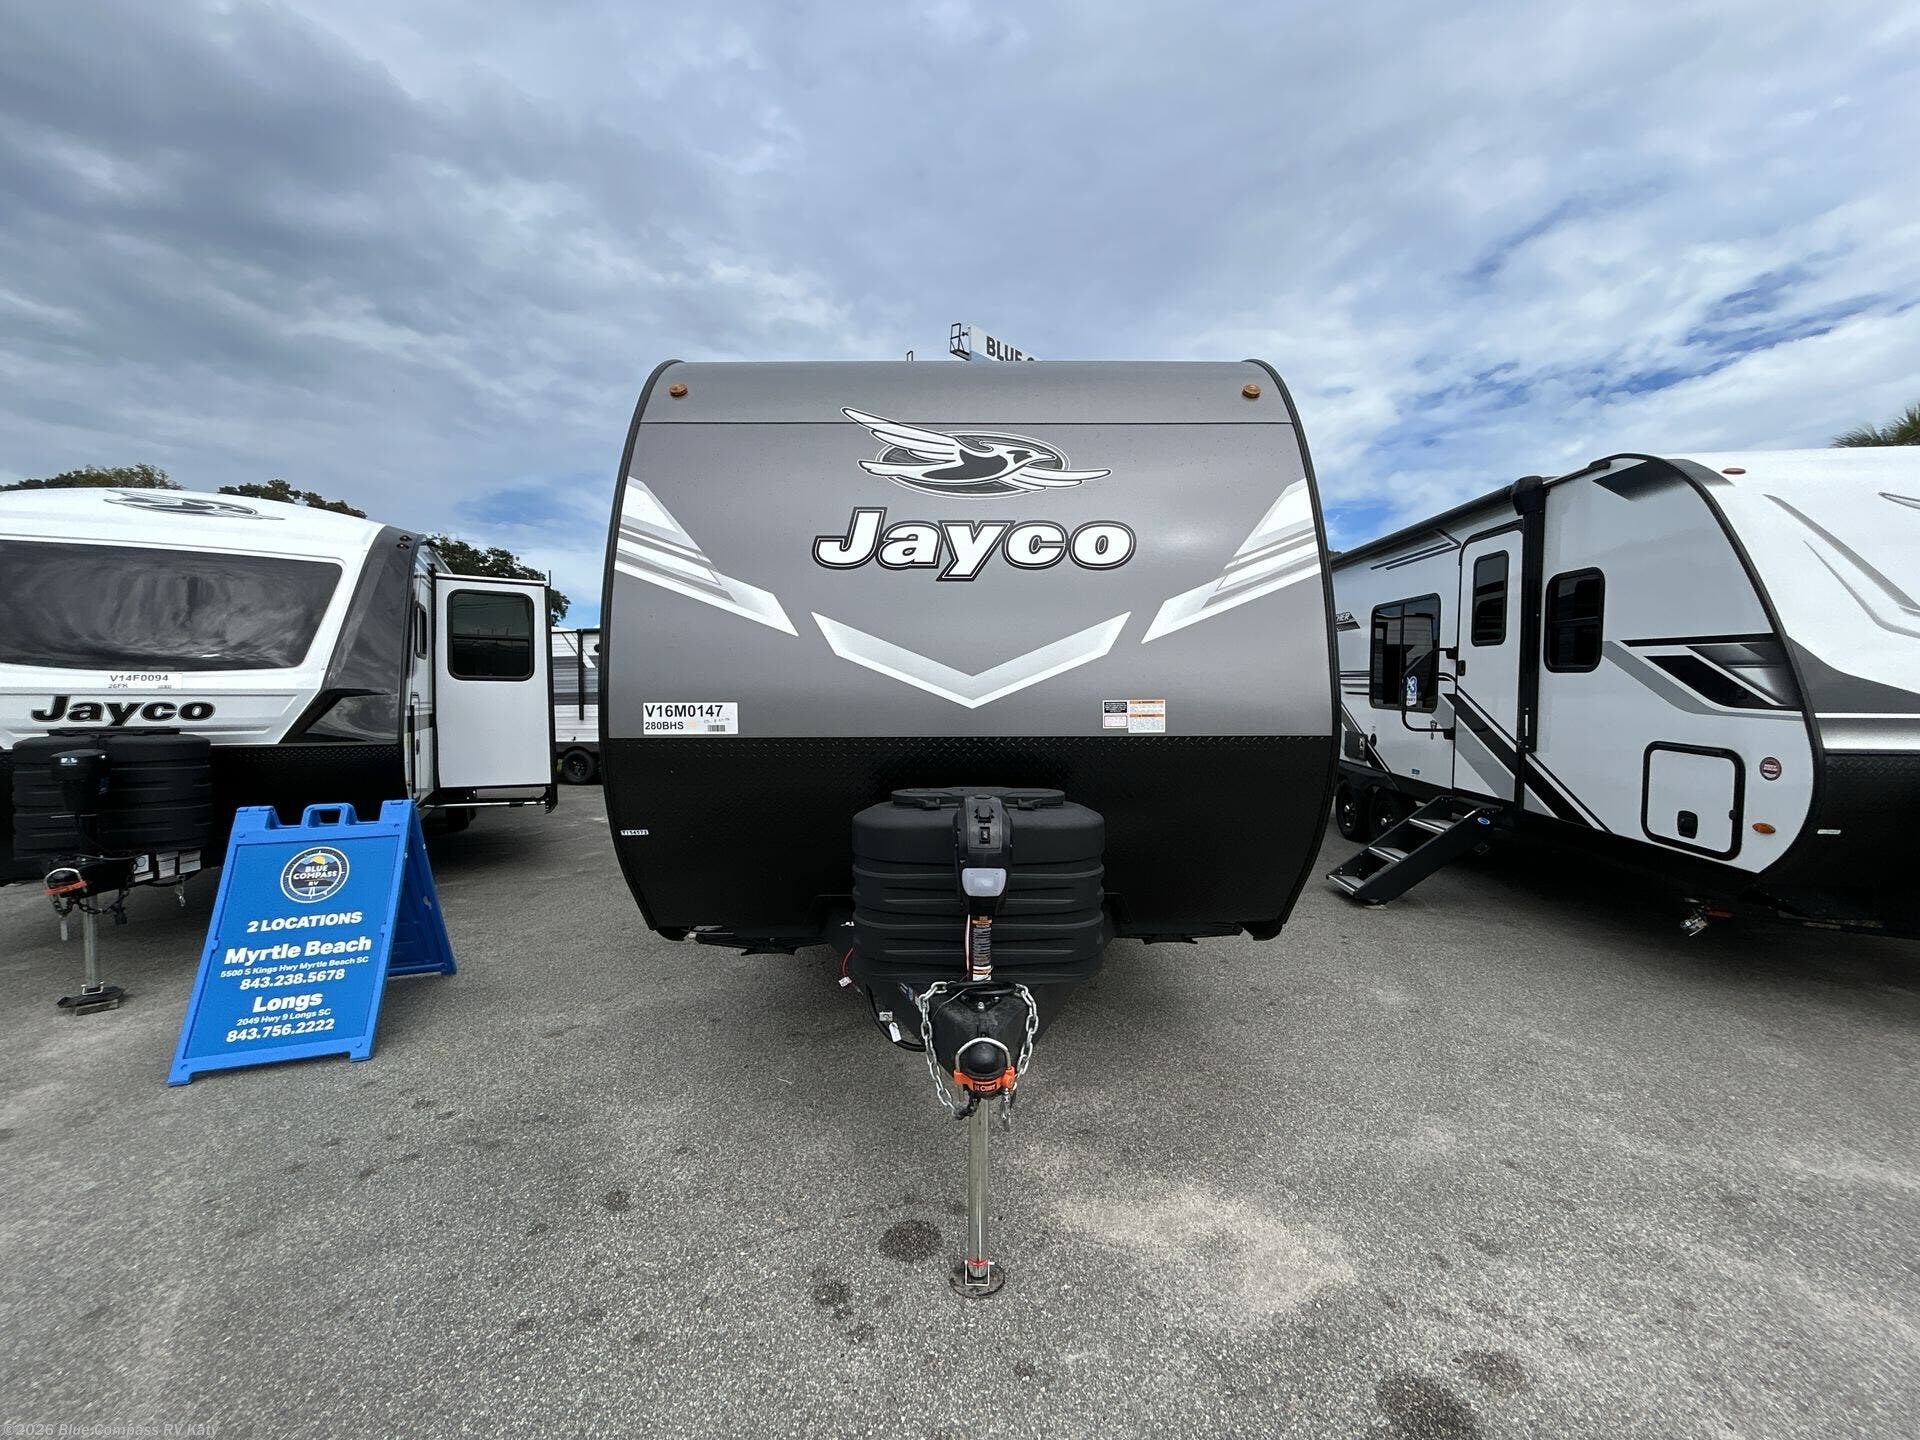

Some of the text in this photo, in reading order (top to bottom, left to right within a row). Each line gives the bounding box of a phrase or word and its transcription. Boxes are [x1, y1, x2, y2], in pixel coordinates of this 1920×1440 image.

[811, 506, 1137, 582] Jayco
[110, 674, 168, 682] V14F0094
[30, 694, 216, 727] Jayco
[645, 704, 723, 718] V16M0147
[645, 721, 684, 730] 280BHS
[293, 870, 338, 880] COMPASS
[304, 865, 329, 873] BLUE
[246, 911, 363, 933] 2 LOCATIONS
[224, 936, 372, 967] Myrtle Beach
[244, 968, 252, 976] S
[252, 966, 278, 975] Kings
[279, 963, 298, 972] Hwy
[299, 961, 327, 971] Myrtle
[328, 958, 356, 967] Beach
[356, 956, 369, 964] SC
[240, 968, 346, 990] 843.238.5678
[252, 992, 324, 1013] Longs
[236, 1018, 260, 1027] 2049
[260, 1015, 281, 1024] Hwy
[289, 1011, 317, 1020] Longs
[318, 1008, 332, 1016] SC
[225, 1018, 335, 1043] 843.756.2222
